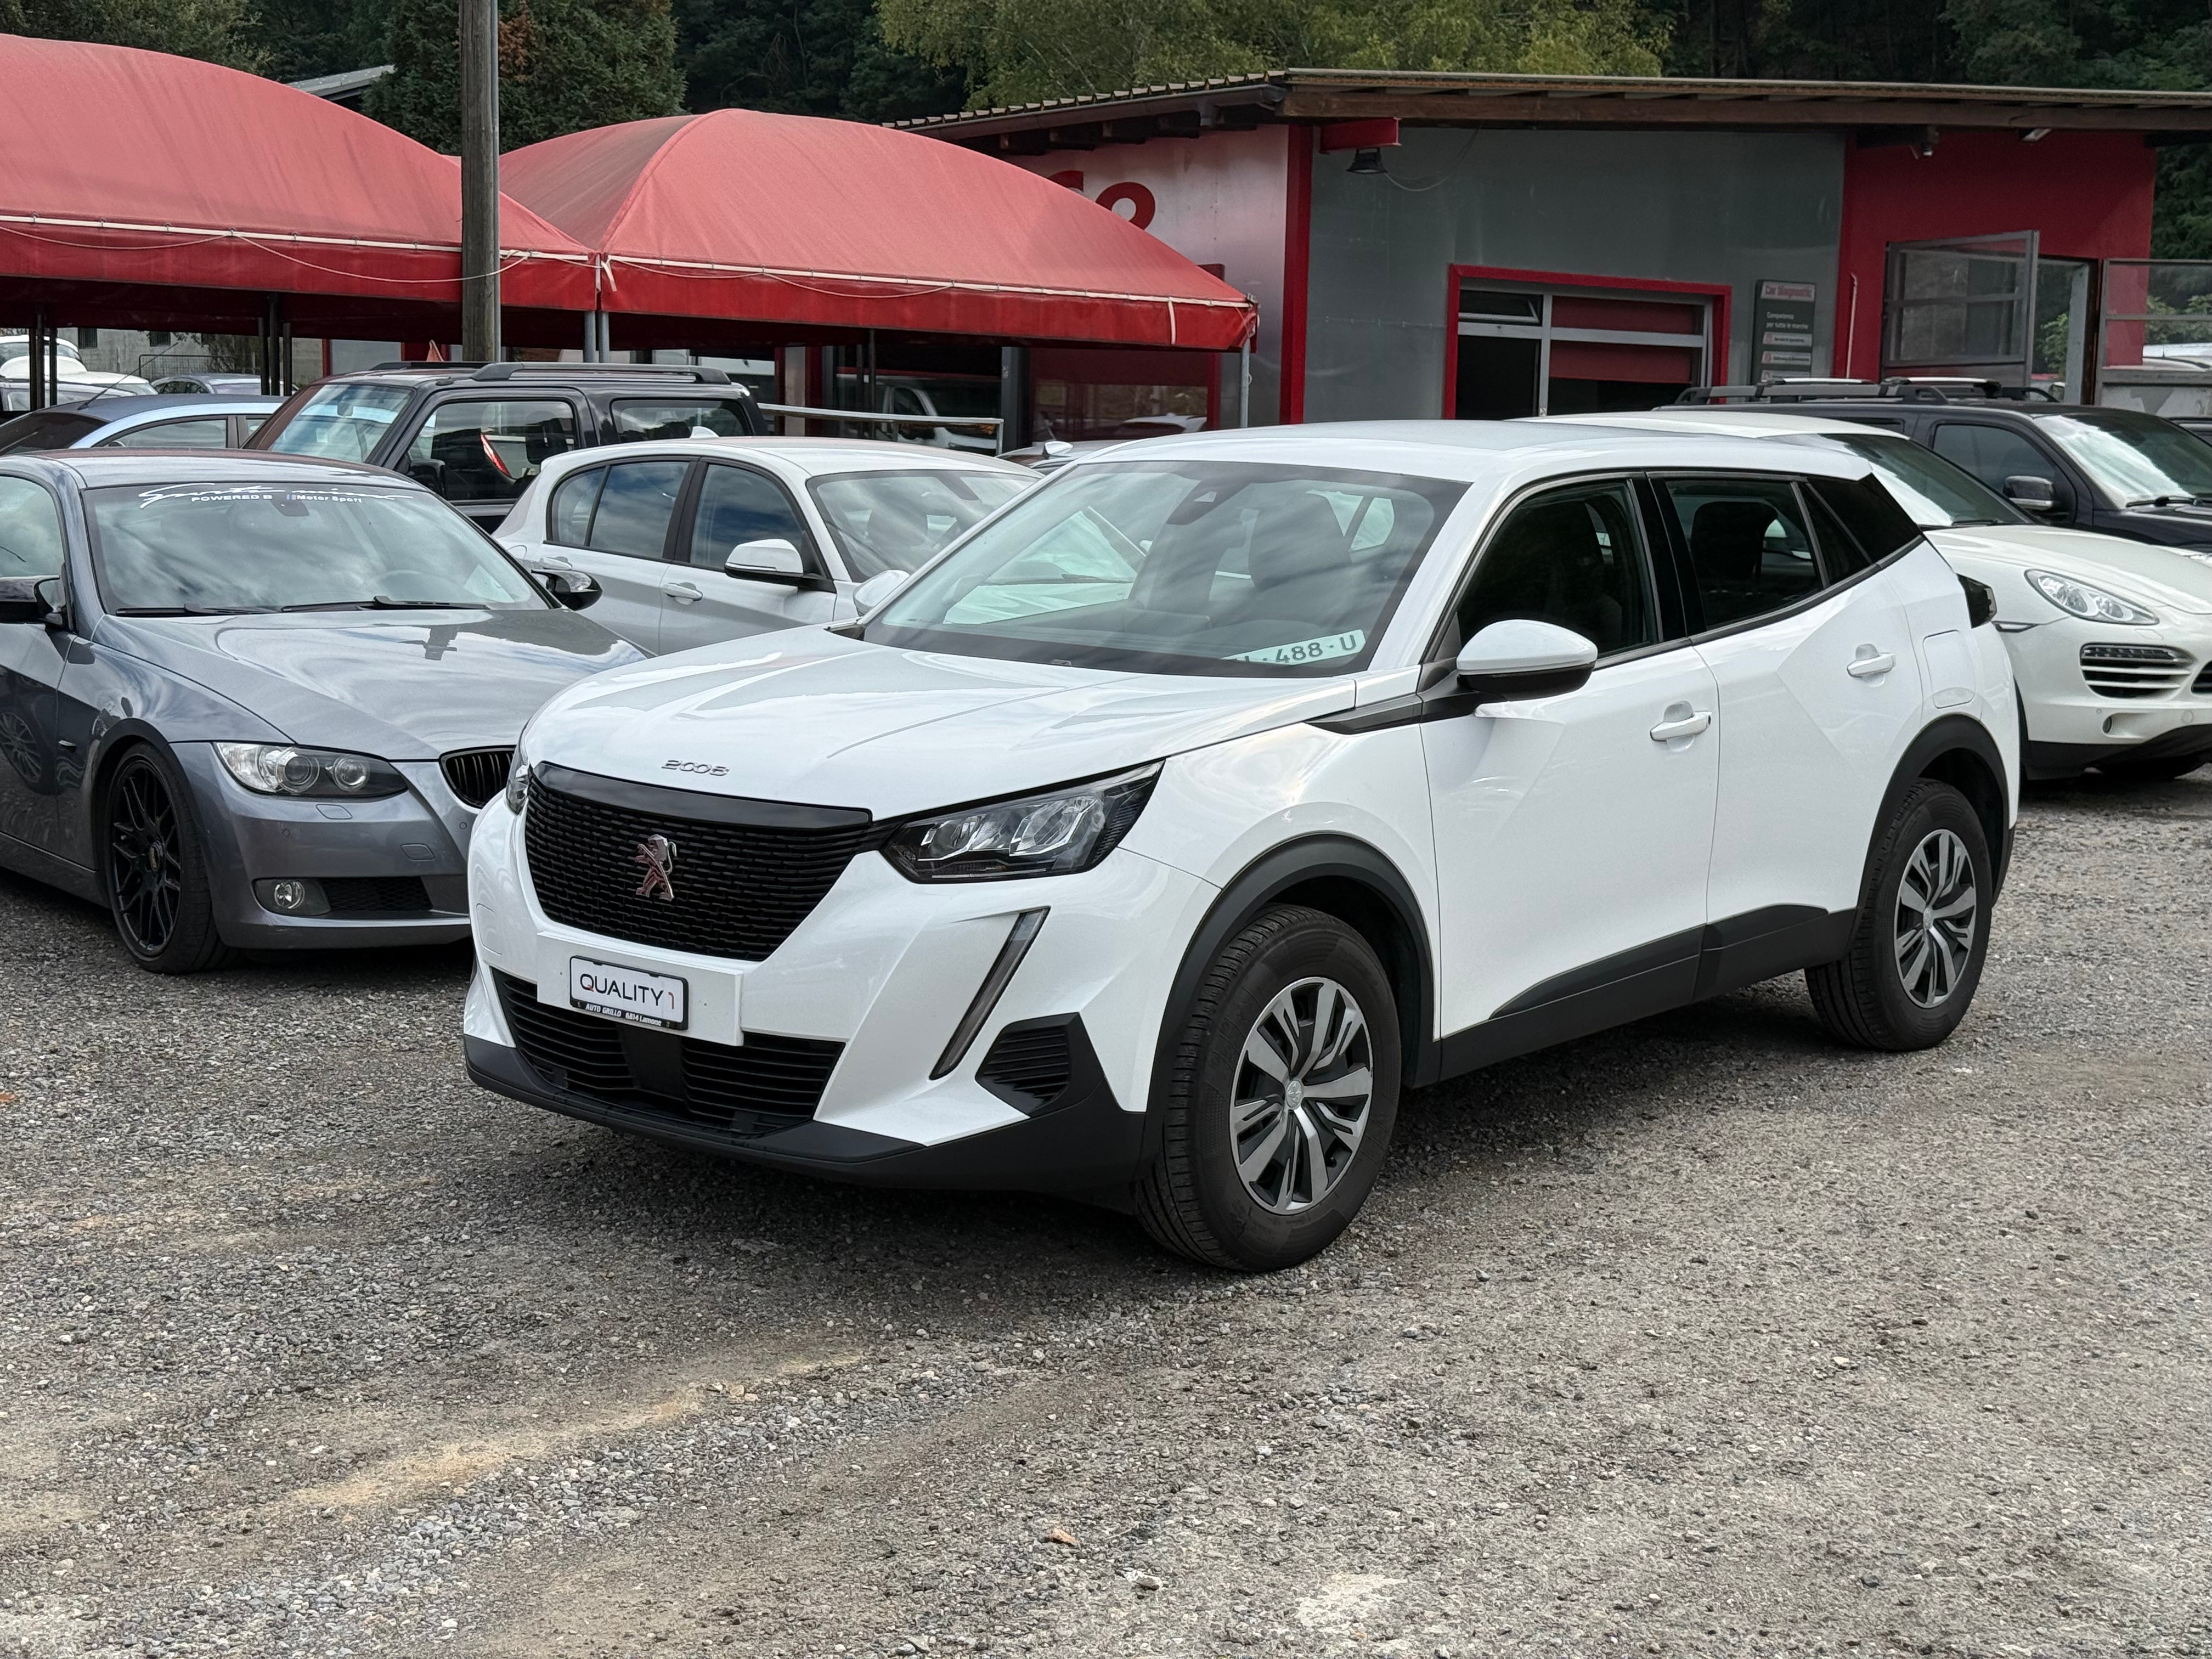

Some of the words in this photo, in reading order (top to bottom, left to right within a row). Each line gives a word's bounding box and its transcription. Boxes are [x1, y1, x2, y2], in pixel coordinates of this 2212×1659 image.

[661, 760, 730, 776] 2008
[580, 973, 664, 1006] QUALITY
[585, 1003, 601, 1013] AUTO
[602, 1007, 622, 1017] GRILLO
